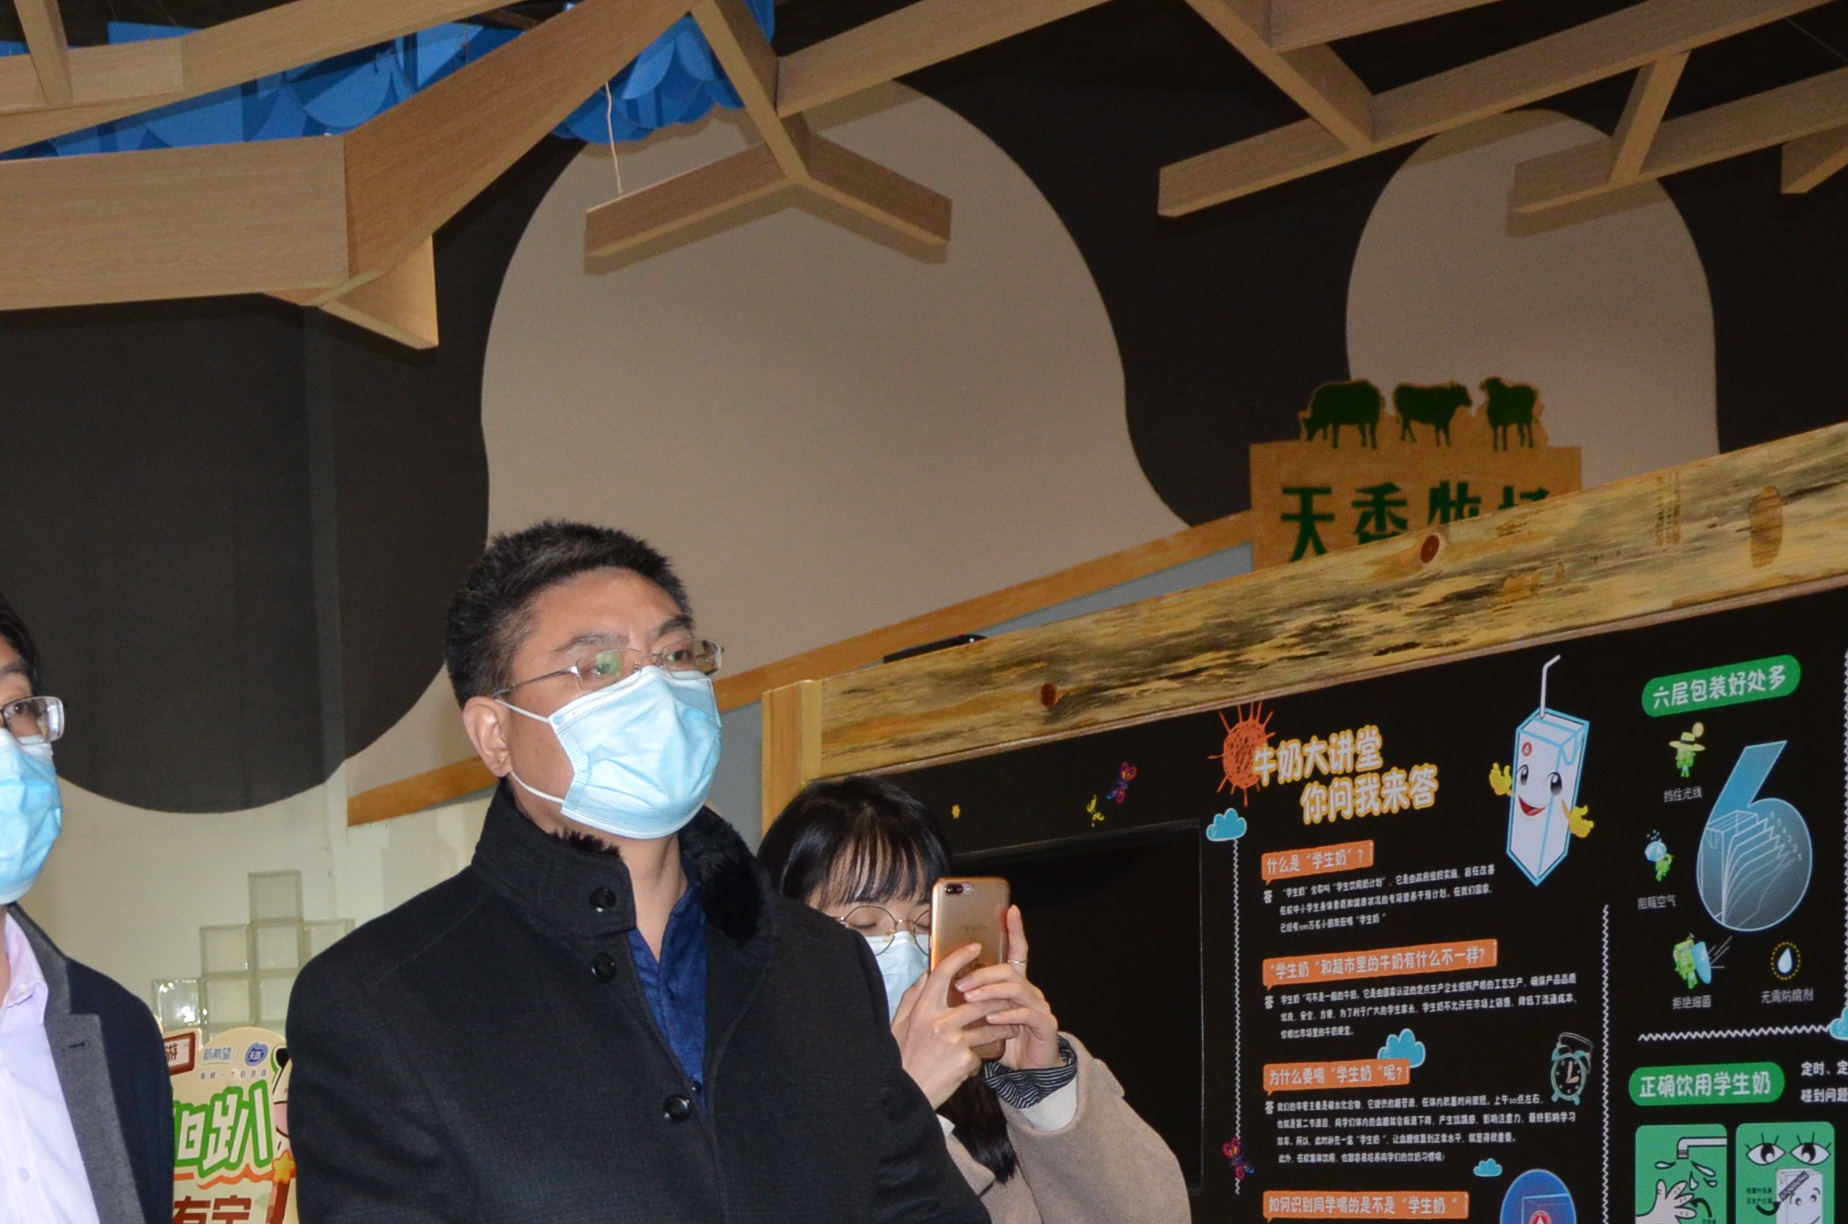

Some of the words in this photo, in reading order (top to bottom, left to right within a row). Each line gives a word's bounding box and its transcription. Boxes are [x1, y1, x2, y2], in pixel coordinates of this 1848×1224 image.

[1280, 480, 1549, 562] 天香牧
[1652, 664, 1787, 710] 六层包装好处多
[1253, 724, 1383, 787] 牛奶大讲堂
[1300, 762, 1439, 824] 你问我来答
[1663, 787, 1703, 803] 挡住光线
[1639, 1071, 1772, 1098] 正确饮用学生奶
